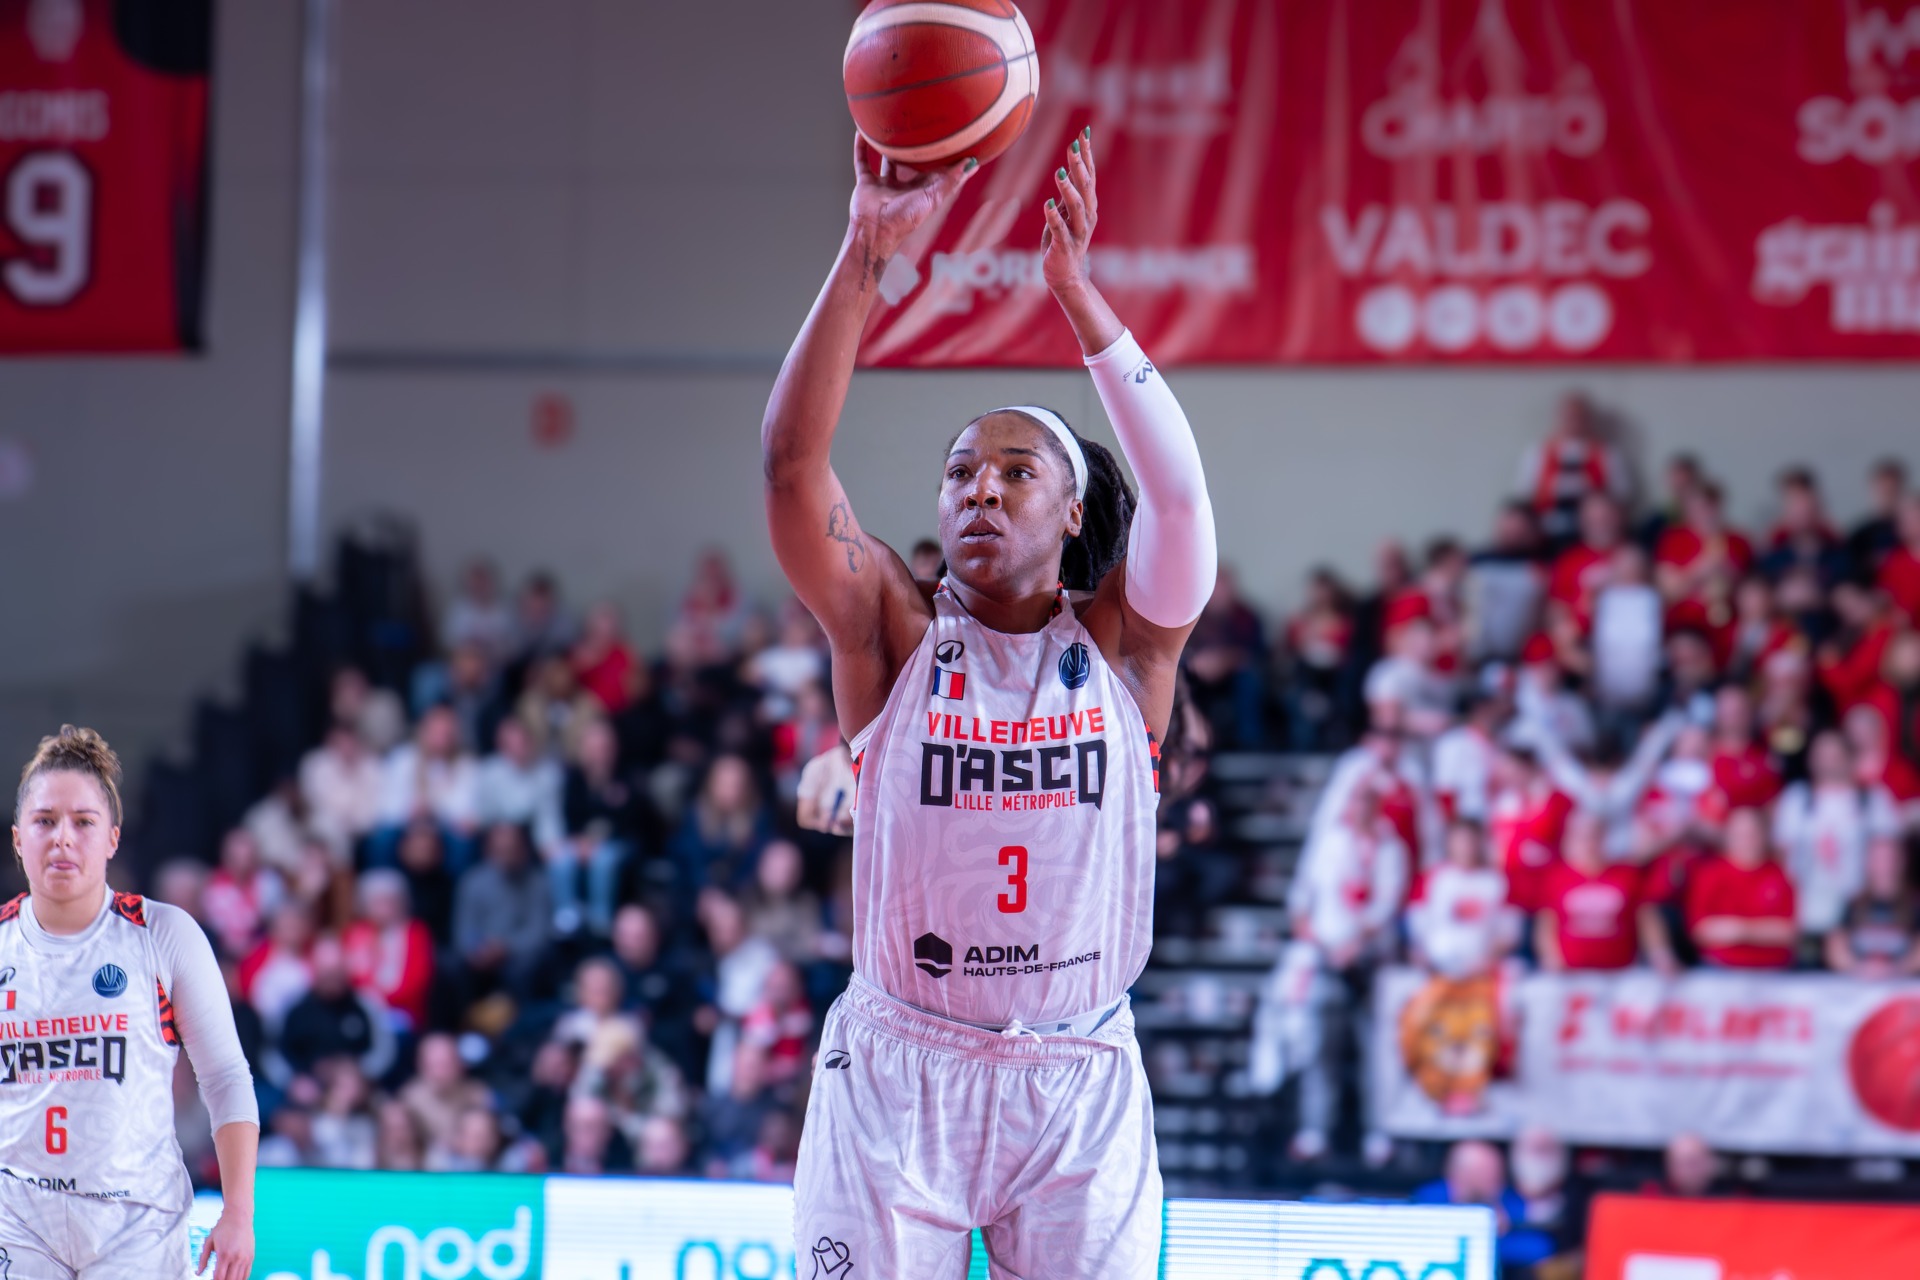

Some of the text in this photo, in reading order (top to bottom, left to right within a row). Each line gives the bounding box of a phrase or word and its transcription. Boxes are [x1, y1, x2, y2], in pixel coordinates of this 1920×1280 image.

[4, 151, 93, 307] 9
[1320, 199, 1652, 277] VALDEC
[927, 707, 1105, 745] VILLENEUVE
[920, 739, 1107, 811] D'ASCQ
[954, 790, 1077, 811] LILLE MÉTROPOLE
[997, 845, 1028, 914] 3
[963, 951, 1102, 977] HAUTS-DE-FRANCE
[964, 943, 1039, 964] ADIM
[46, 1106, 68, 1155] 6
